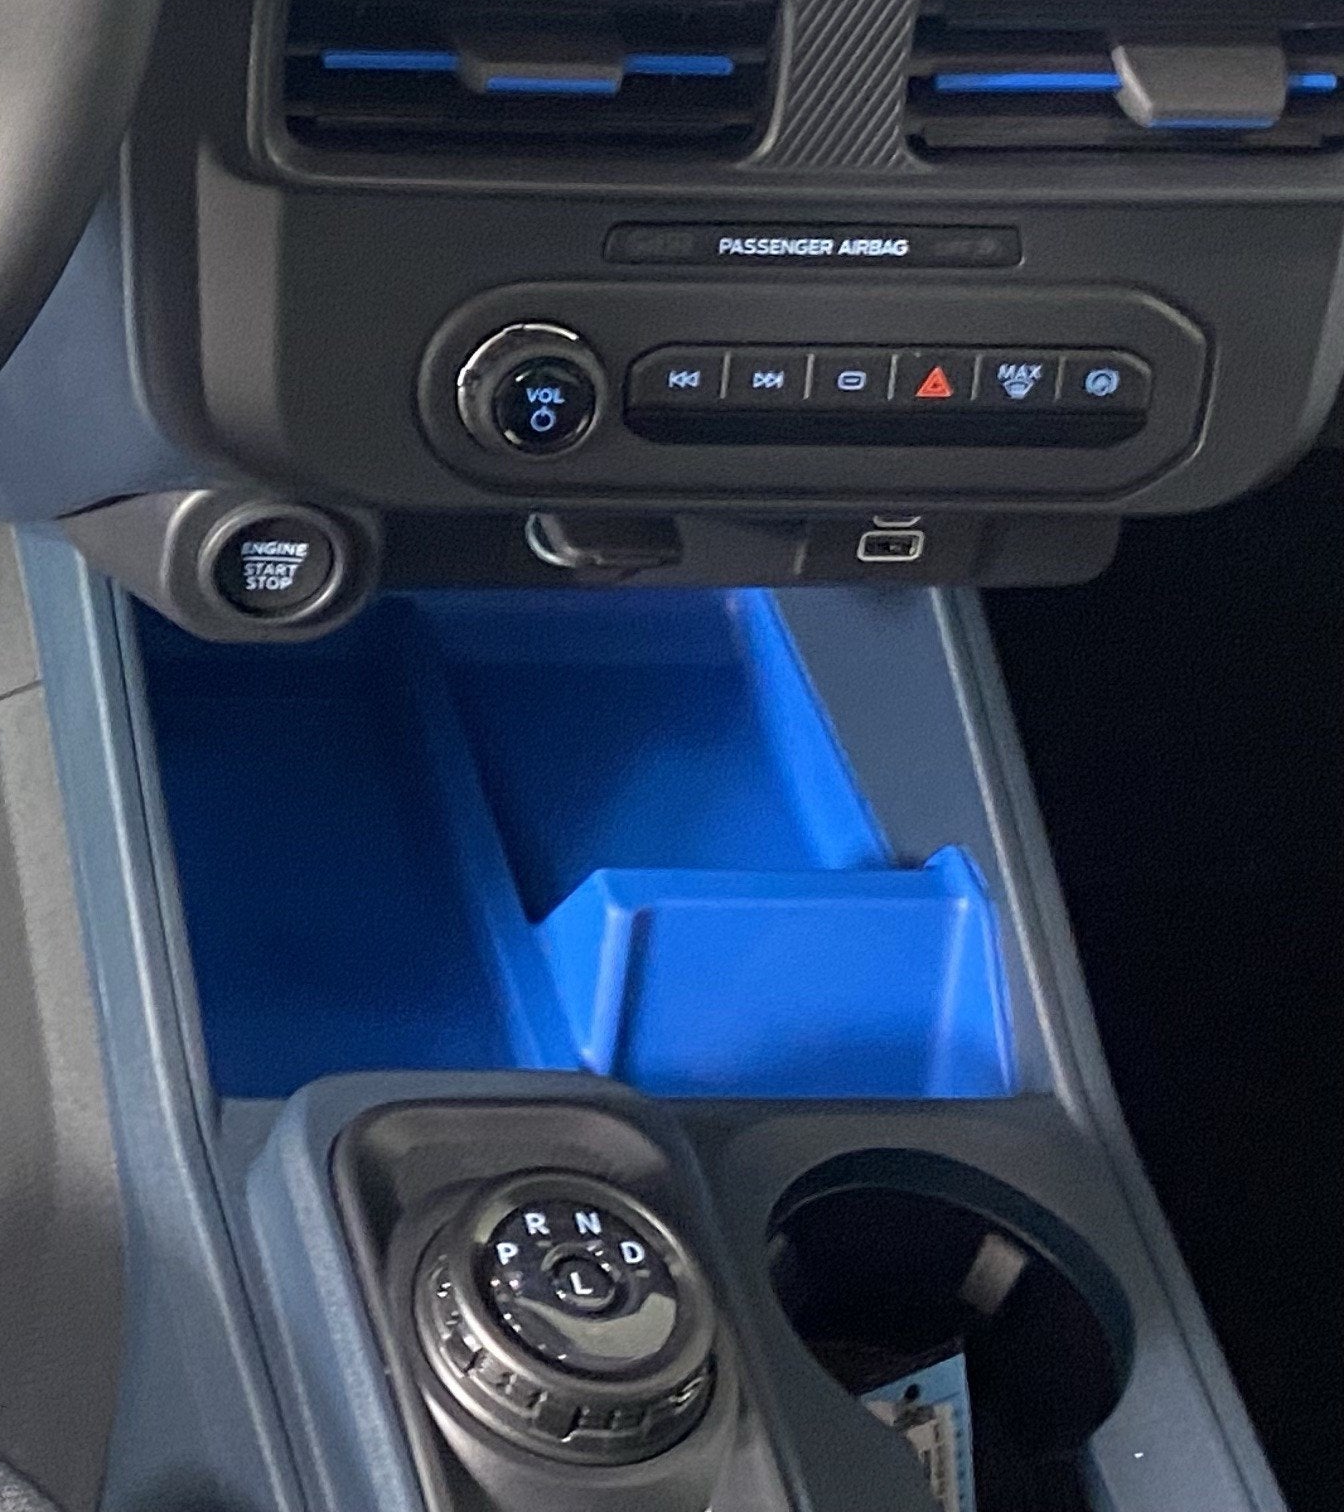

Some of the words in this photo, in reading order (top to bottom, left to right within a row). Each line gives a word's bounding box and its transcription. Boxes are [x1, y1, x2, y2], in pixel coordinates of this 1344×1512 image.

[719, 237, 834, 256] PASSENGER
[837, 238, 910, 257] AIRBAG
[997, 363, 1043, 380] MAX
[526, 387, 566, 404] VOL
[241, 541, 309, 557] ENGINE
[243, 562, 300, 576] START
[246, 575, 294, 590] STOP
[496, 1242, 519, 1266] P
[524, 1212, 550, 1235] R
[575, 1212, 602, 1235] N
[620, 1241, 646, 1264] D
[570, 1271, 593, 1295] L
